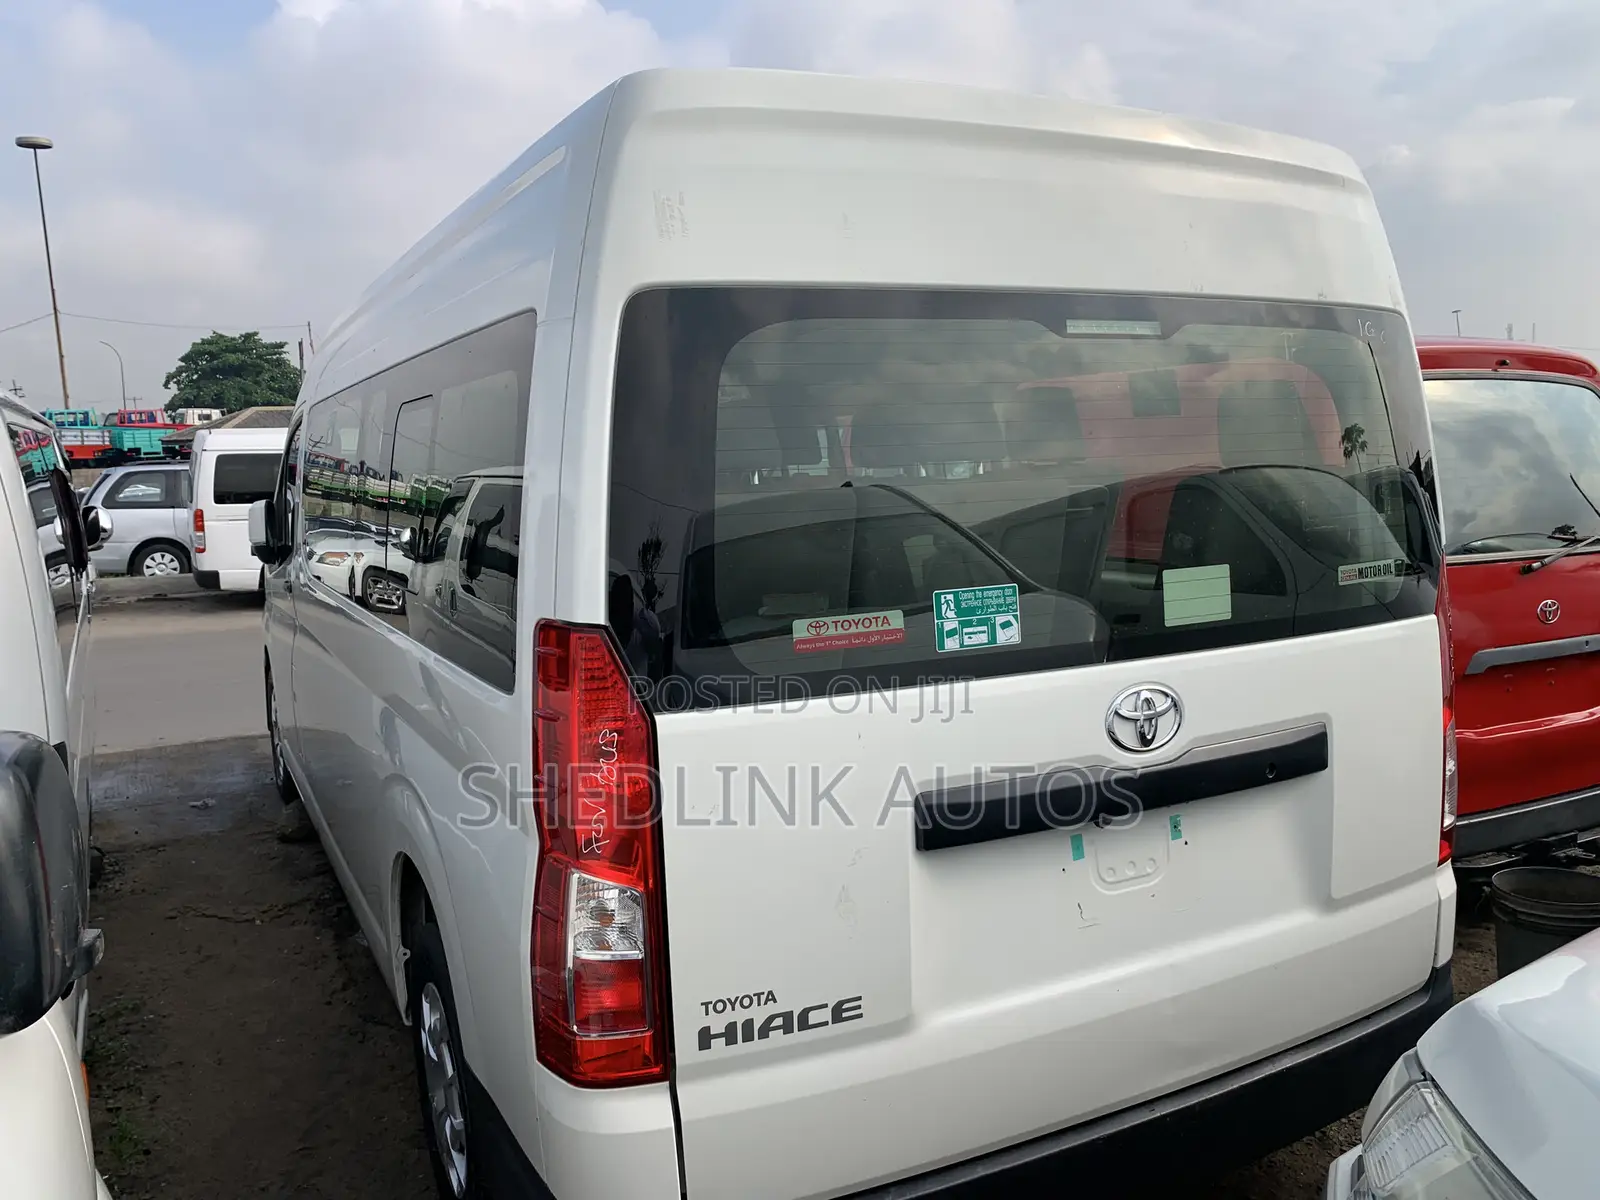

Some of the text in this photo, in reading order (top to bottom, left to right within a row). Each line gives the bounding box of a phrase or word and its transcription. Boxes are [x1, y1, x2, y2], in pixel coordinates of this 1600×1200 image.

[1358, 564, 1381, 579] MOTOR
[1382, 563, 1393, 575] OIL
[959, 591, 975, 601] Opening
[983, 589, 1003, 600] emergency
[1004, 588, 1013, 596] door
[832, 616, 891, 632] TOYOTA
[990, 616, 995, 624] 3
[796, 642, 815, 650] Always
[700, 989, 778, 1017] TOYOTA
[697, 995, 864, 1052] HIACE
